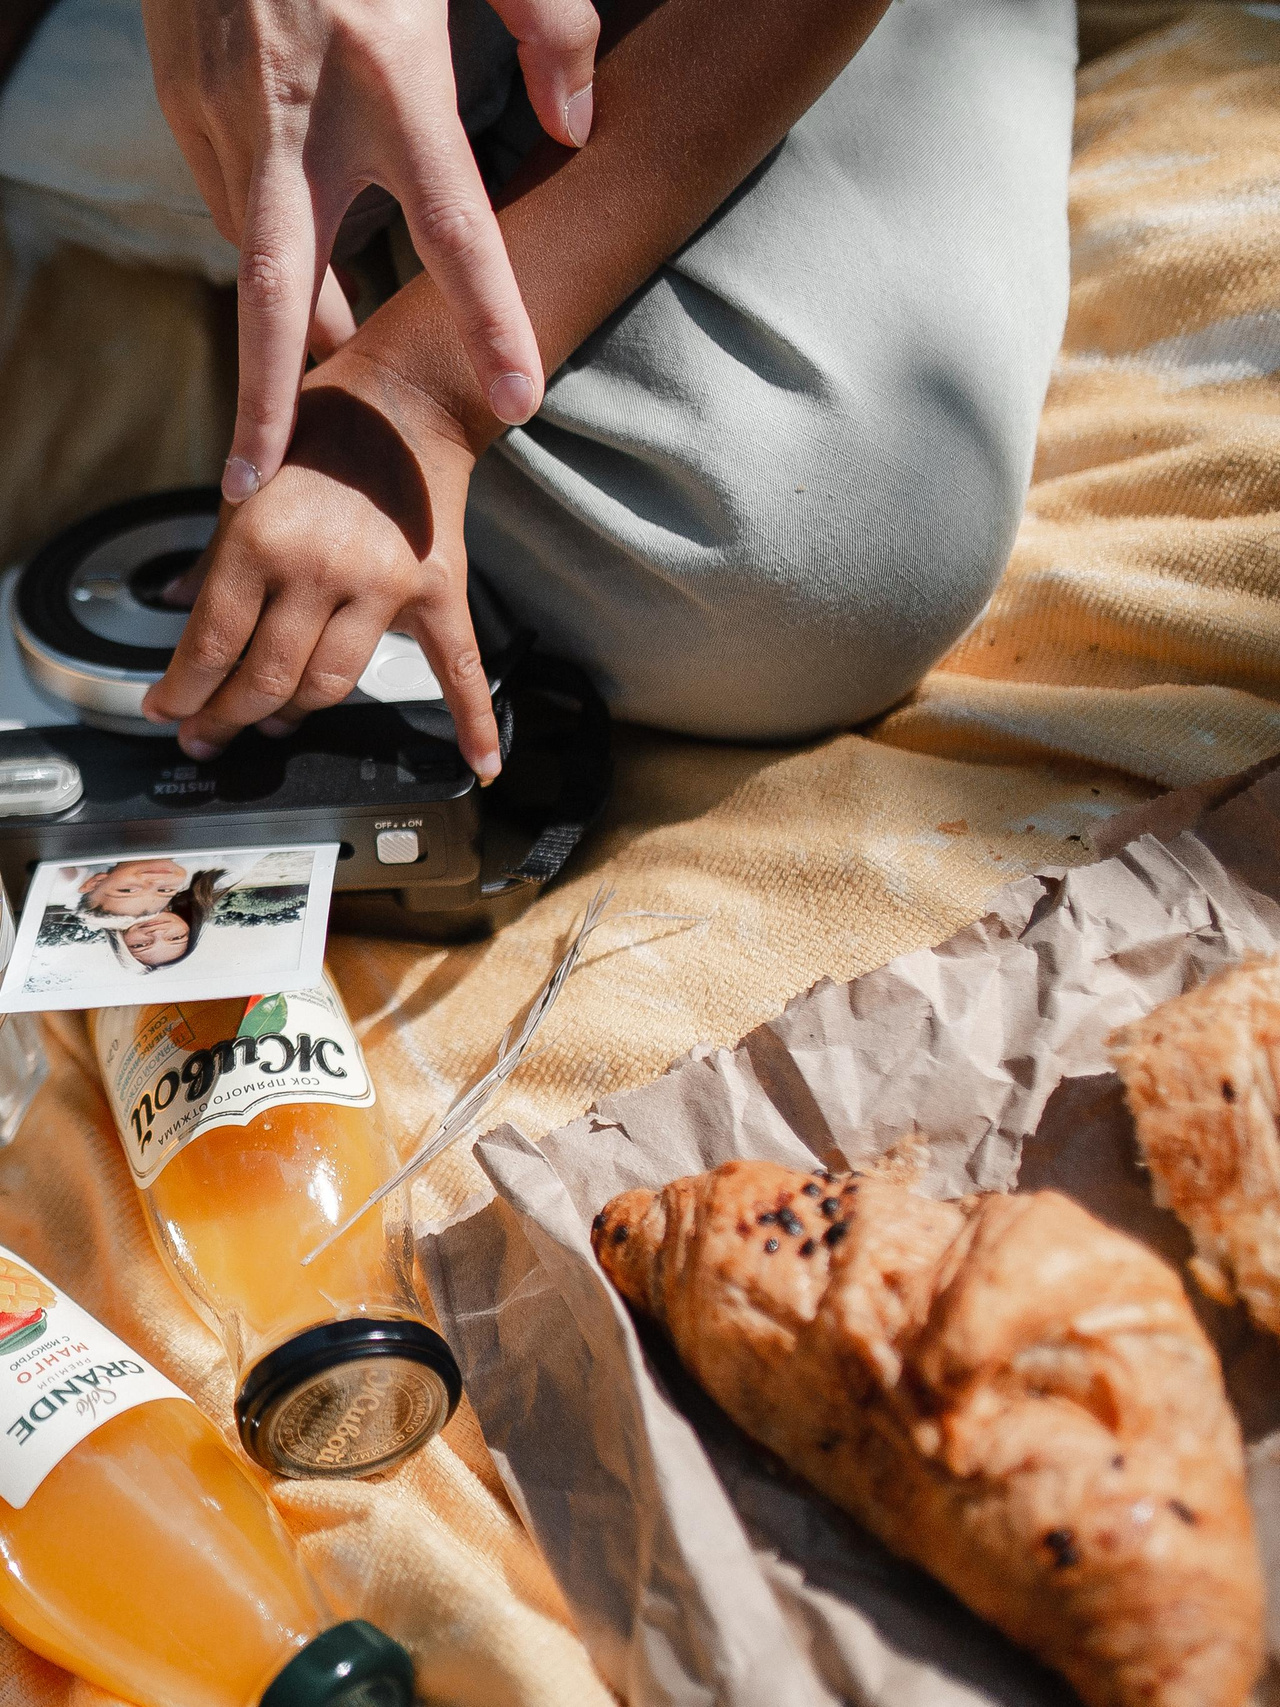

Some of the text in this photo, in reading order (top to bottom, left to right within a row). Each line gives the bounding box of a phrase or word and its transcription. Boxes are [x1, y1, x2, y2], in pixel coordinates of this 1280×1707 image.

[152, 778, 217, 797] instax
[374, 819, 423, 830] OFF ON
[130, 1032, 348, 1156] Живой
[157, 1076, 320, 1147] СОК ПРЯМОГО ОТЖИМА
[16, 1341, 90, 1385] МАНГО
[36, 1356, 93, 1391] PREMIUM
[5, 1358, 145, 1448] GRANDE
[75, 1374, 118, 1421] Soko
[315, 1370, 393, 1464] Живой
[350, 1433, 407, 1462] ОТЖИМА
